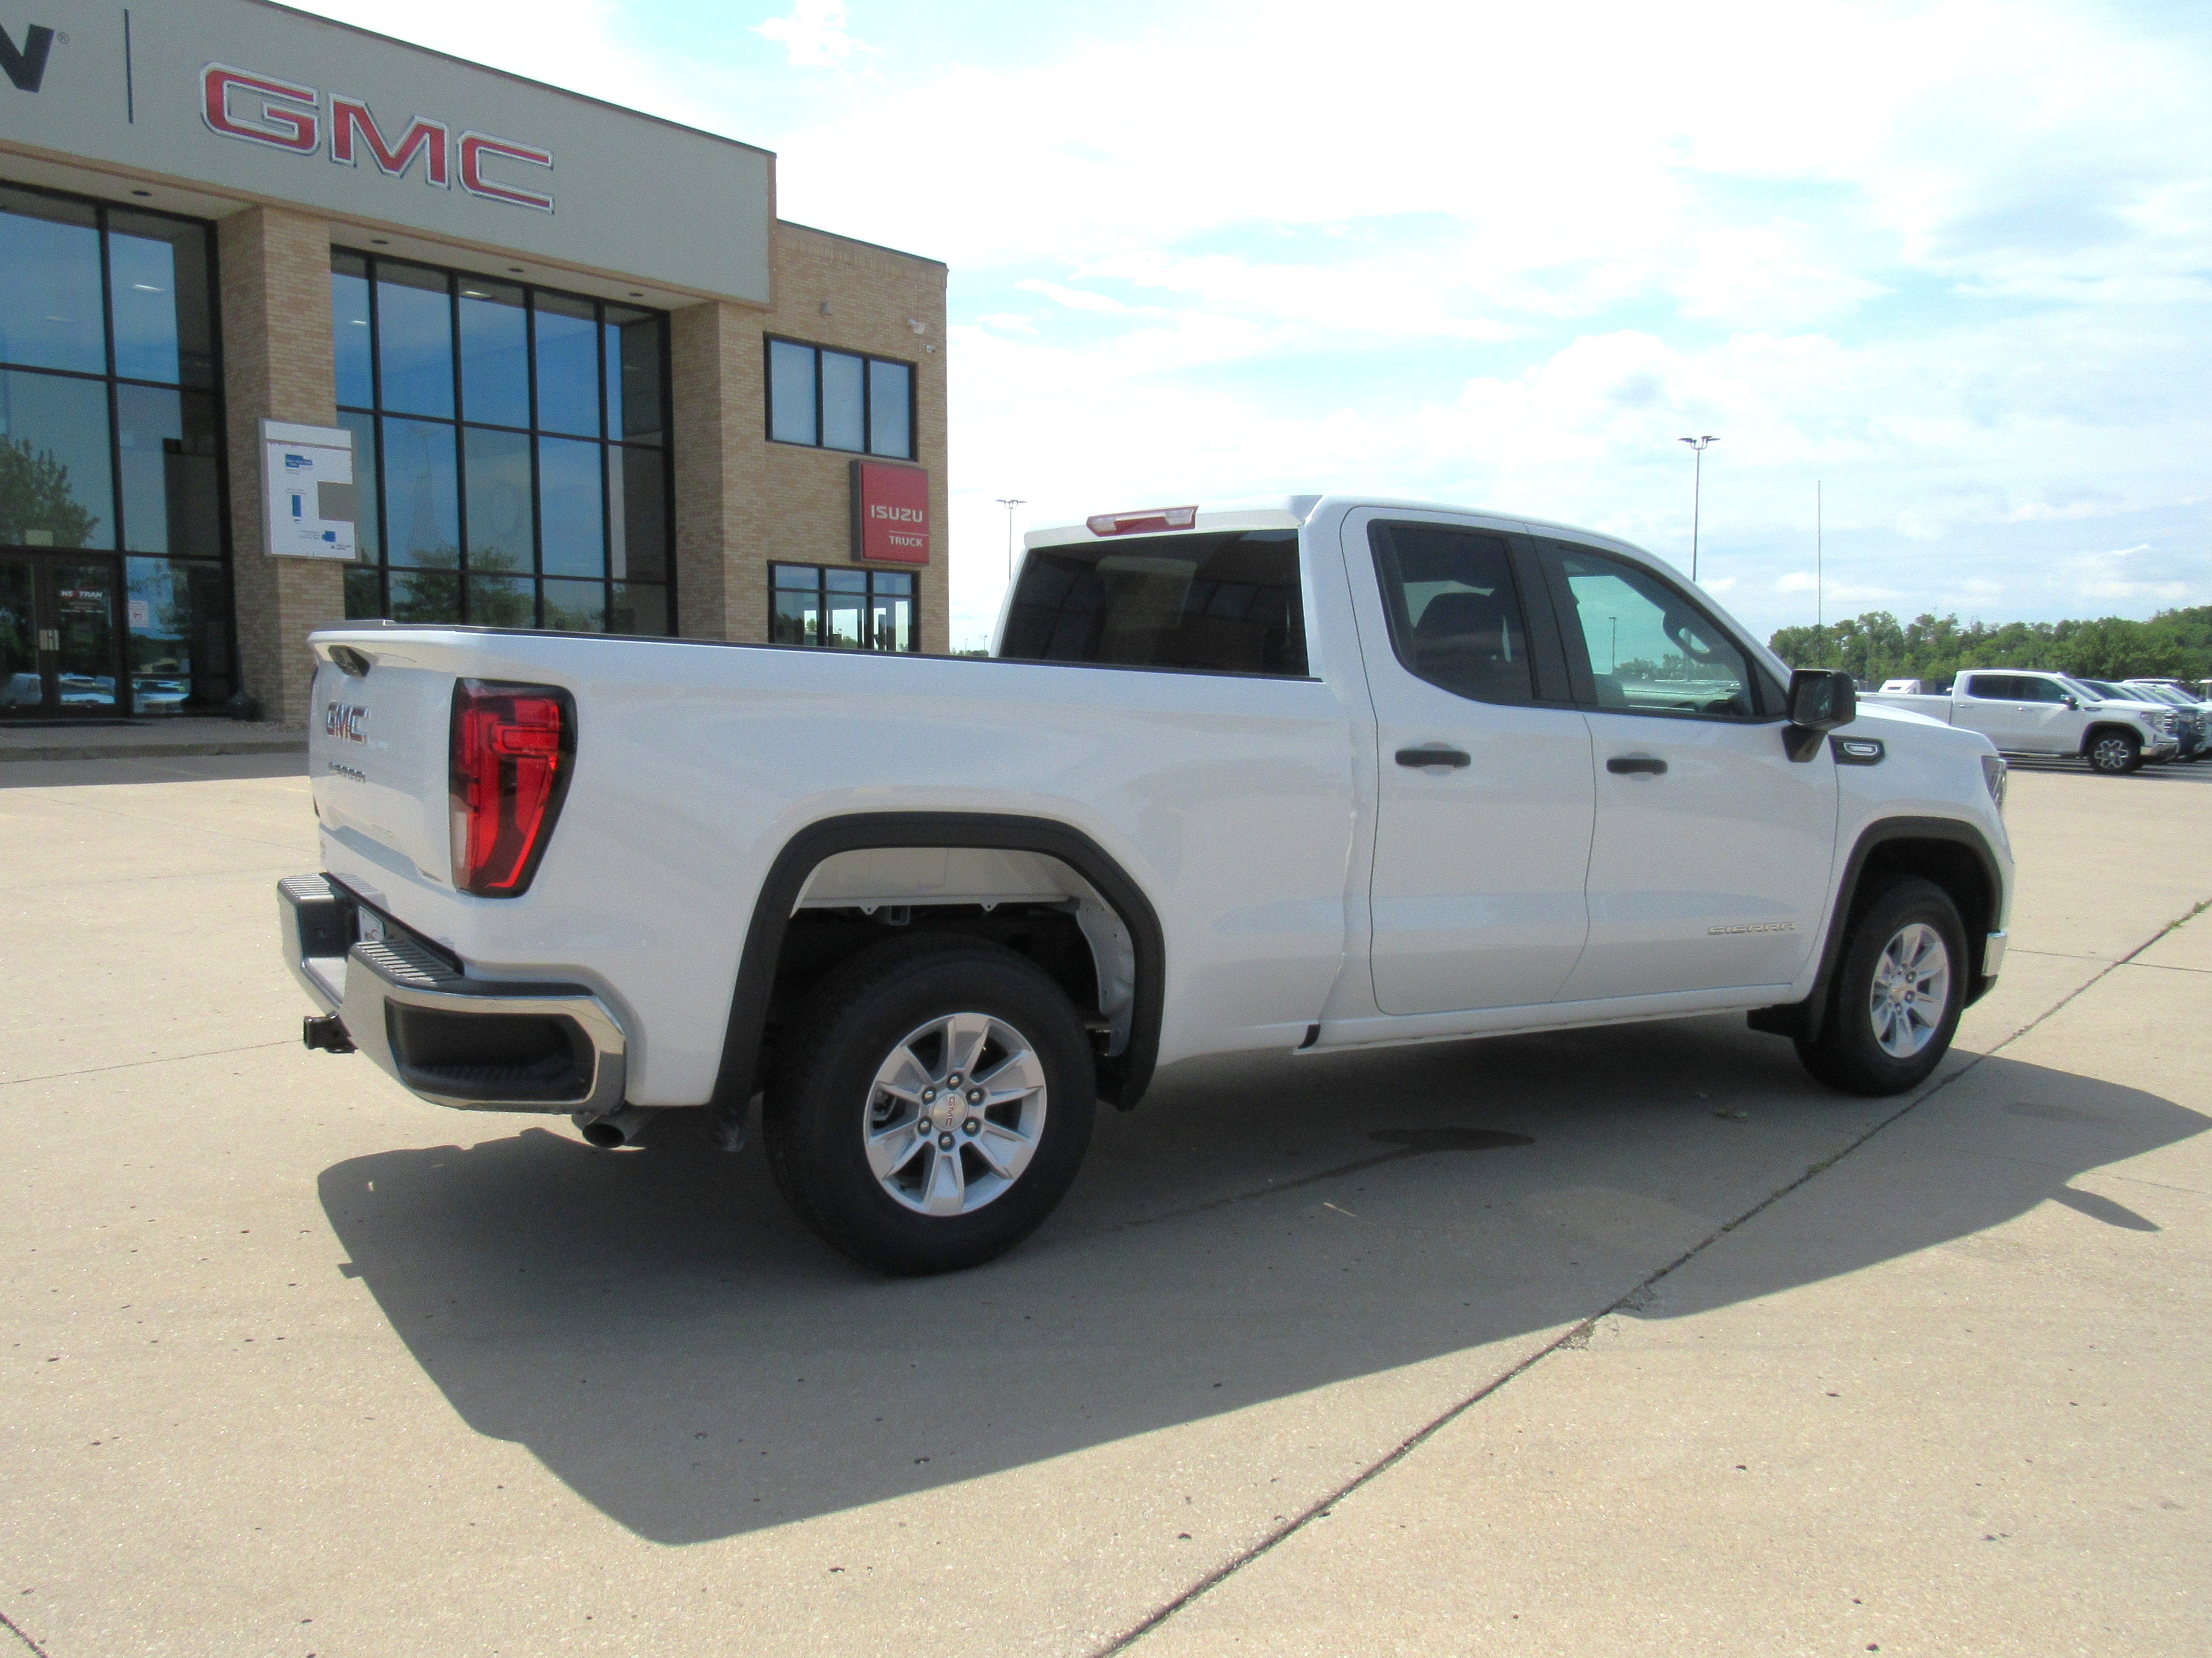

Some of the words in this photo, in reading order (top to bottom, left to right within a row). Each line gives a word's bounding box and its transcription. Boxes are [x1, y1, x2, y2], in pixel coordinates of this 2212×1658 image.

[200, 62, 555, 214] GMC
[871, 505, 923, 523] ISUZU
[889, 536, 923, 547] TRUCK
[326, 701, 370, 744] GMC
[946, 1096, 955, 1126] GMC
